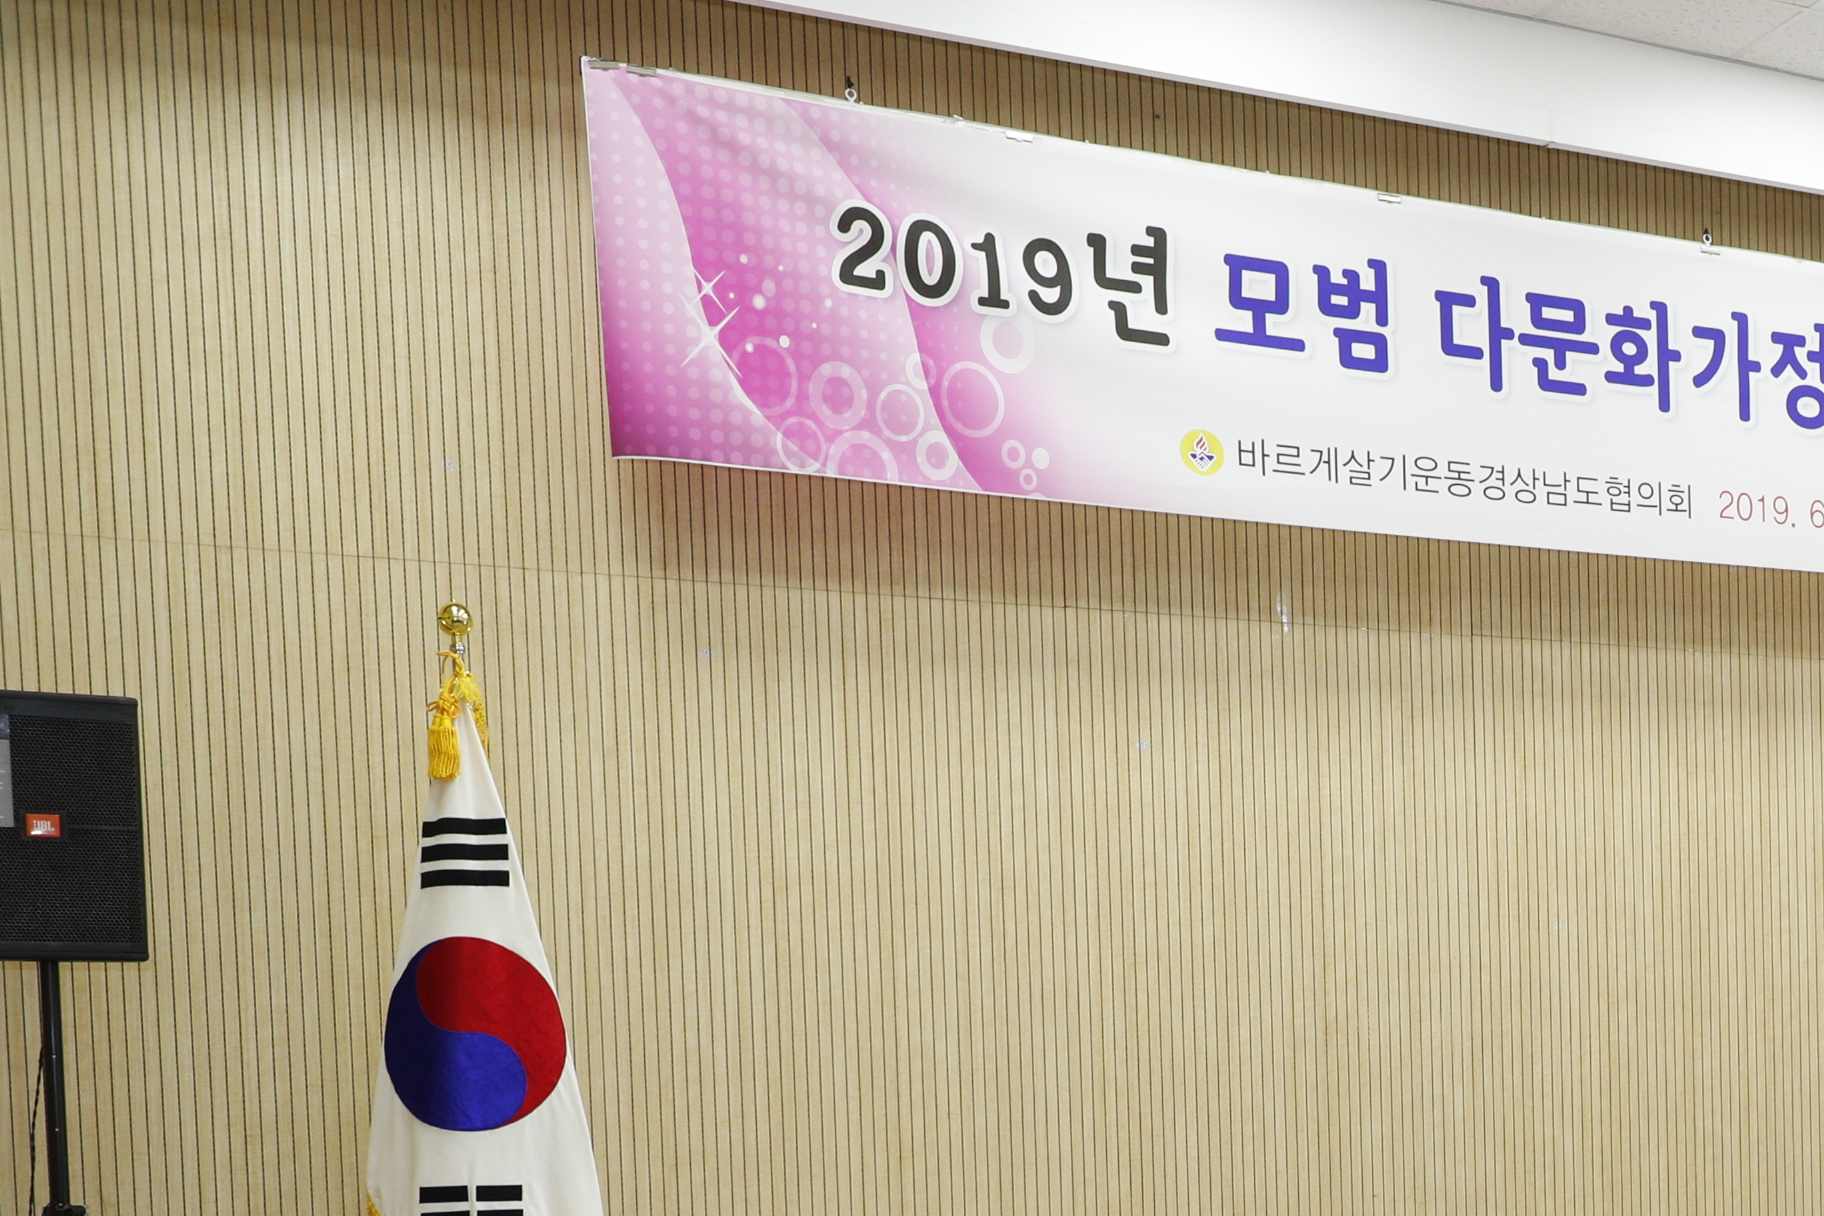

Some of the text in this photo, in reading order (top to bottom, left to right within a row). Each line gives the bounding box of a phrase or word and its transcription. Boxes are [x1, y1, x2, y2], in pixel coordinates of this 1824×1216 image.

[836, 205, 1171, 348] 2019년
[1214, 252, 1390, 374] 모범
[1236, 438, 1693, 519] 바르게살기운동경상남도협의회
[1719, 490, 1797, 528] 2019.
[33, 819, 55, 832] JBL
